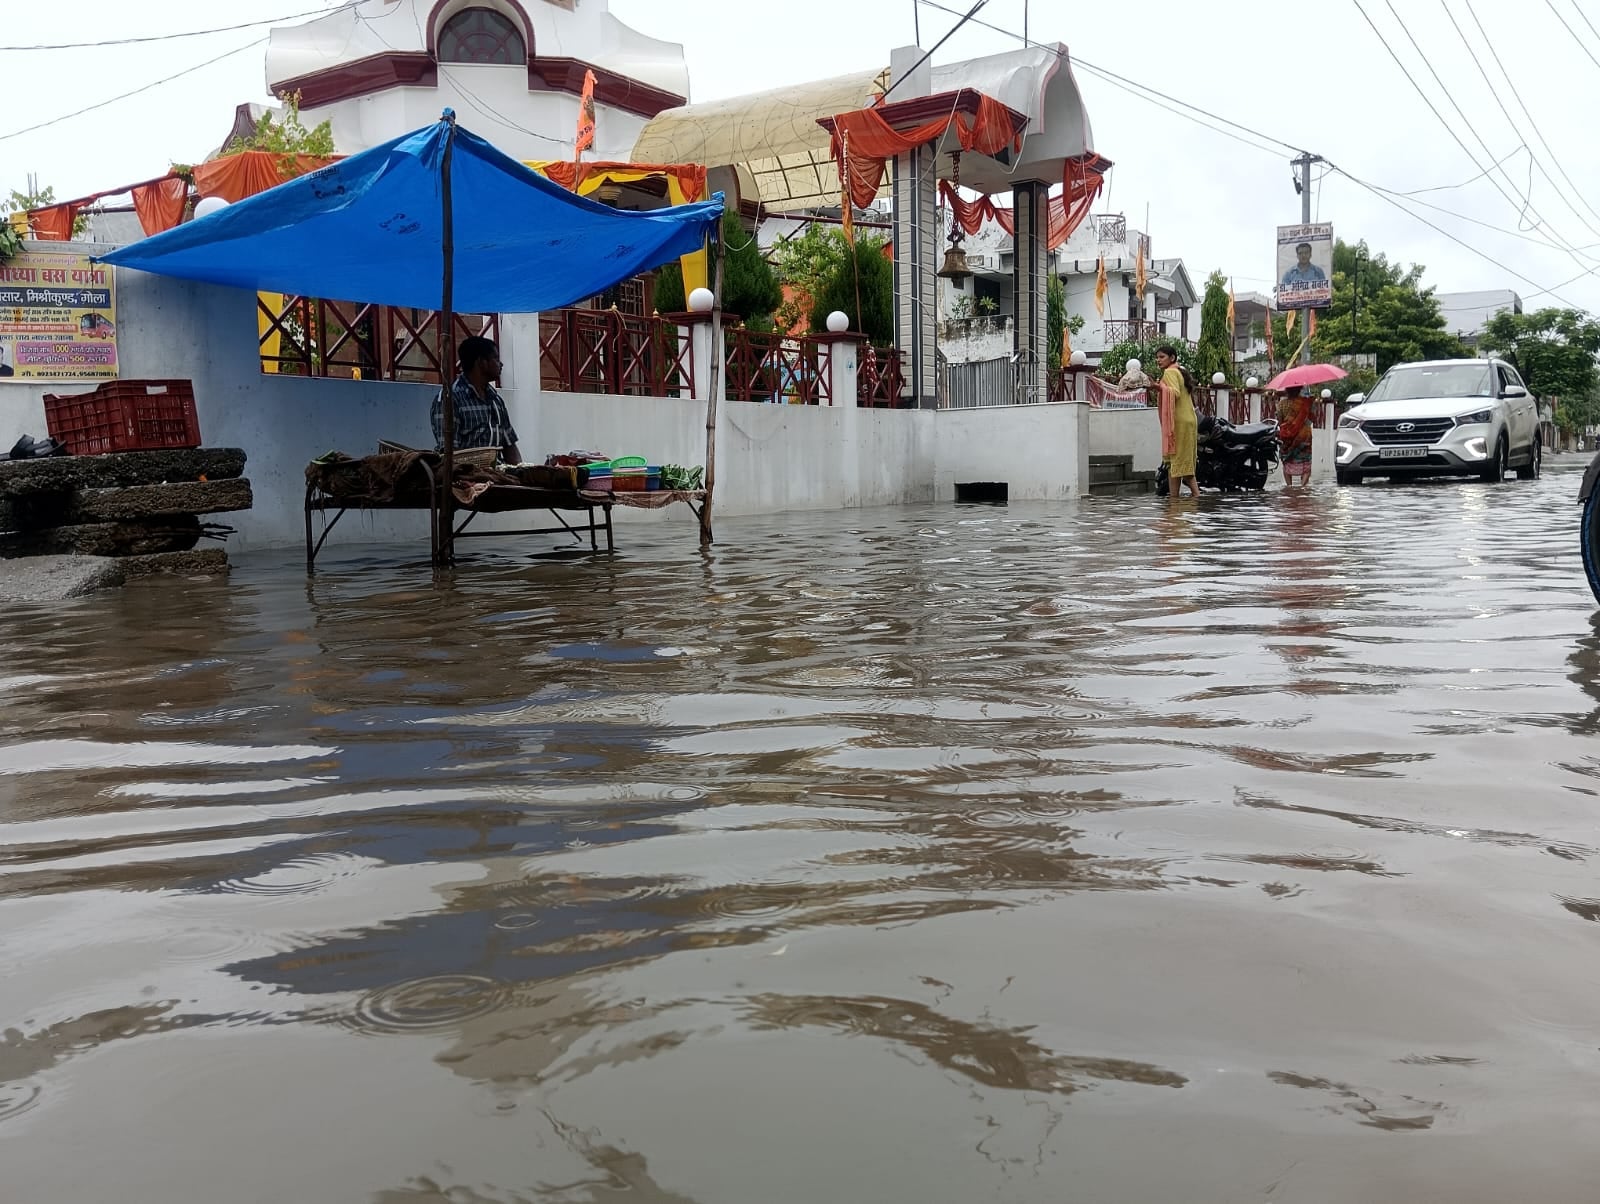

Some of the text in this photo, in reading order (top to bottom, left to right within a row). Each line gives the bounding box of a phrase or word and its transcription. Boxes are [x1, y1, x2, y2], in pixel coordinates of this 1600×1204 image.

[41, 268, 67, 284] बस
[71, 269, 106, 285] यात्रा
[0, 291, 24, 304] सार,
[26, 288, 78, 307] मिश्रीकुण्ड,
[52, 343, 69, 354] 1000
[69, 355, 85, 363] 500
